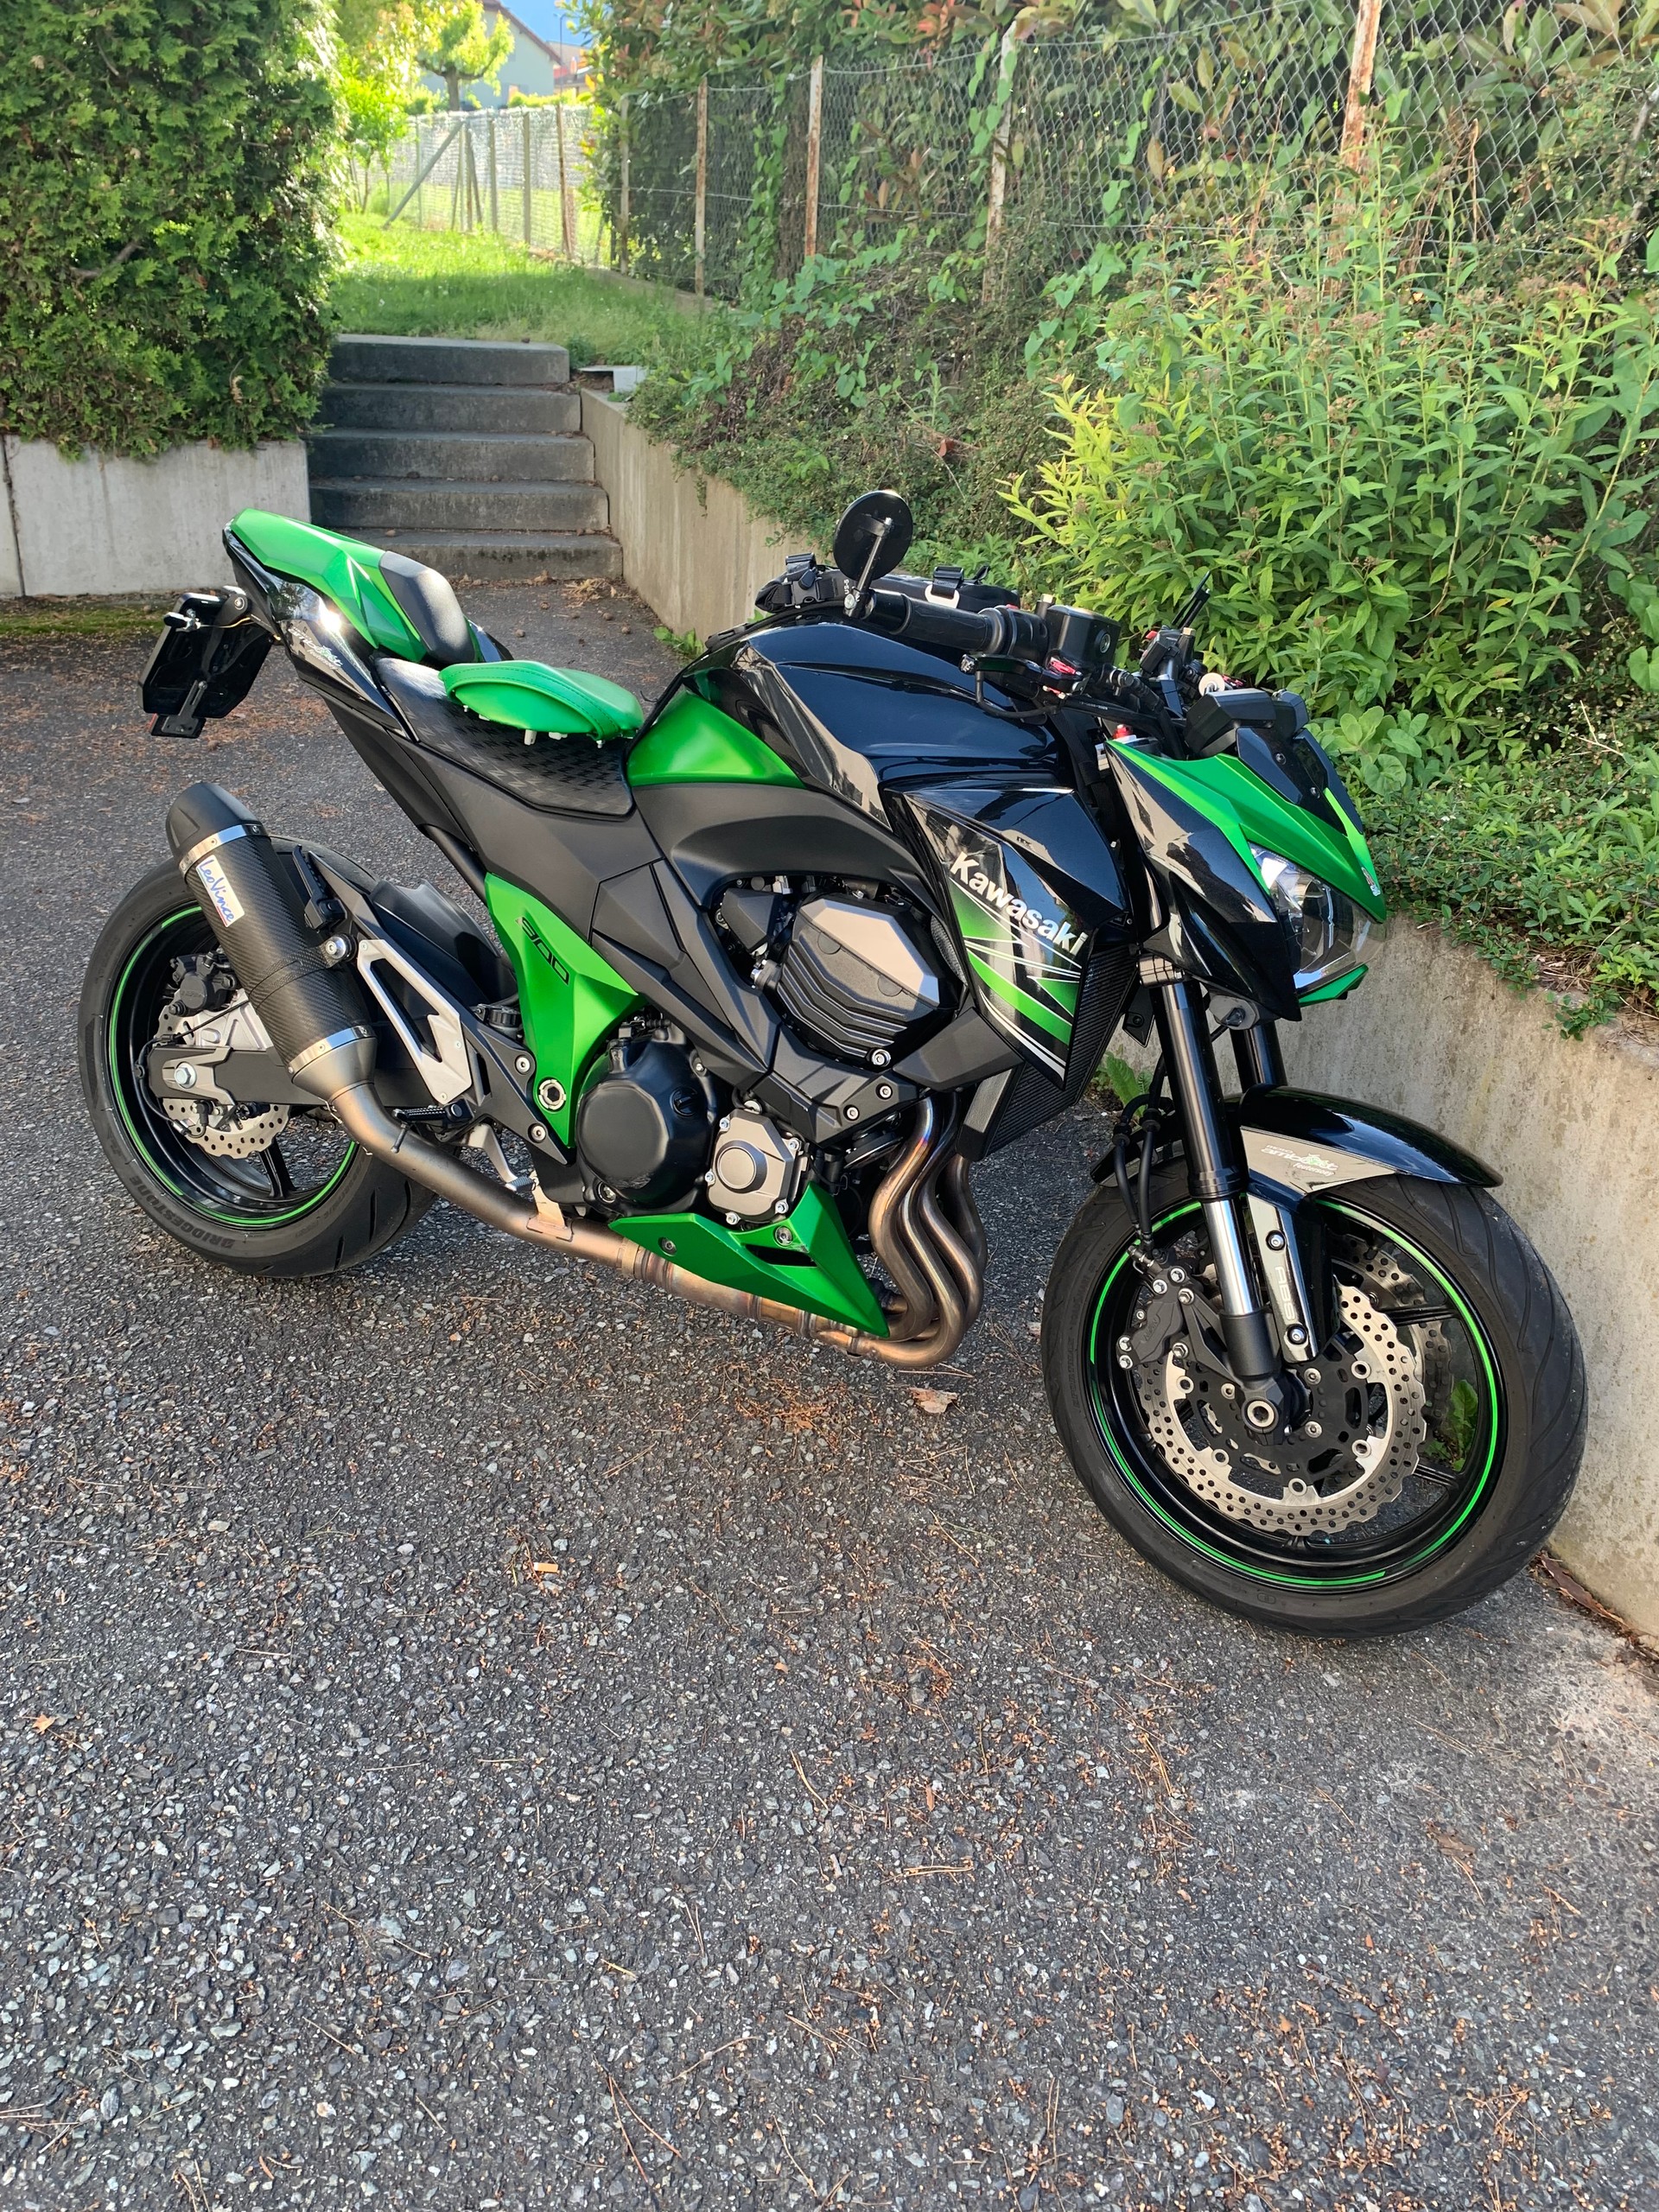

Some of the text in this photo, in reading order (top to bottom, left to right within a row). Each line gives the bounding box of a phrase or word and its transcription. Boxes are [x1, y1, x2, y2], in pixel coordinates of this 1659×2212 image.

[199, 859, 234, 922] LeoVince
[950, 851, 1090, 957] Kawasaki
[129, 1175, 236, 1249] BRIDGESTONE
[1274, 1266, 1296, 1320] ABS
